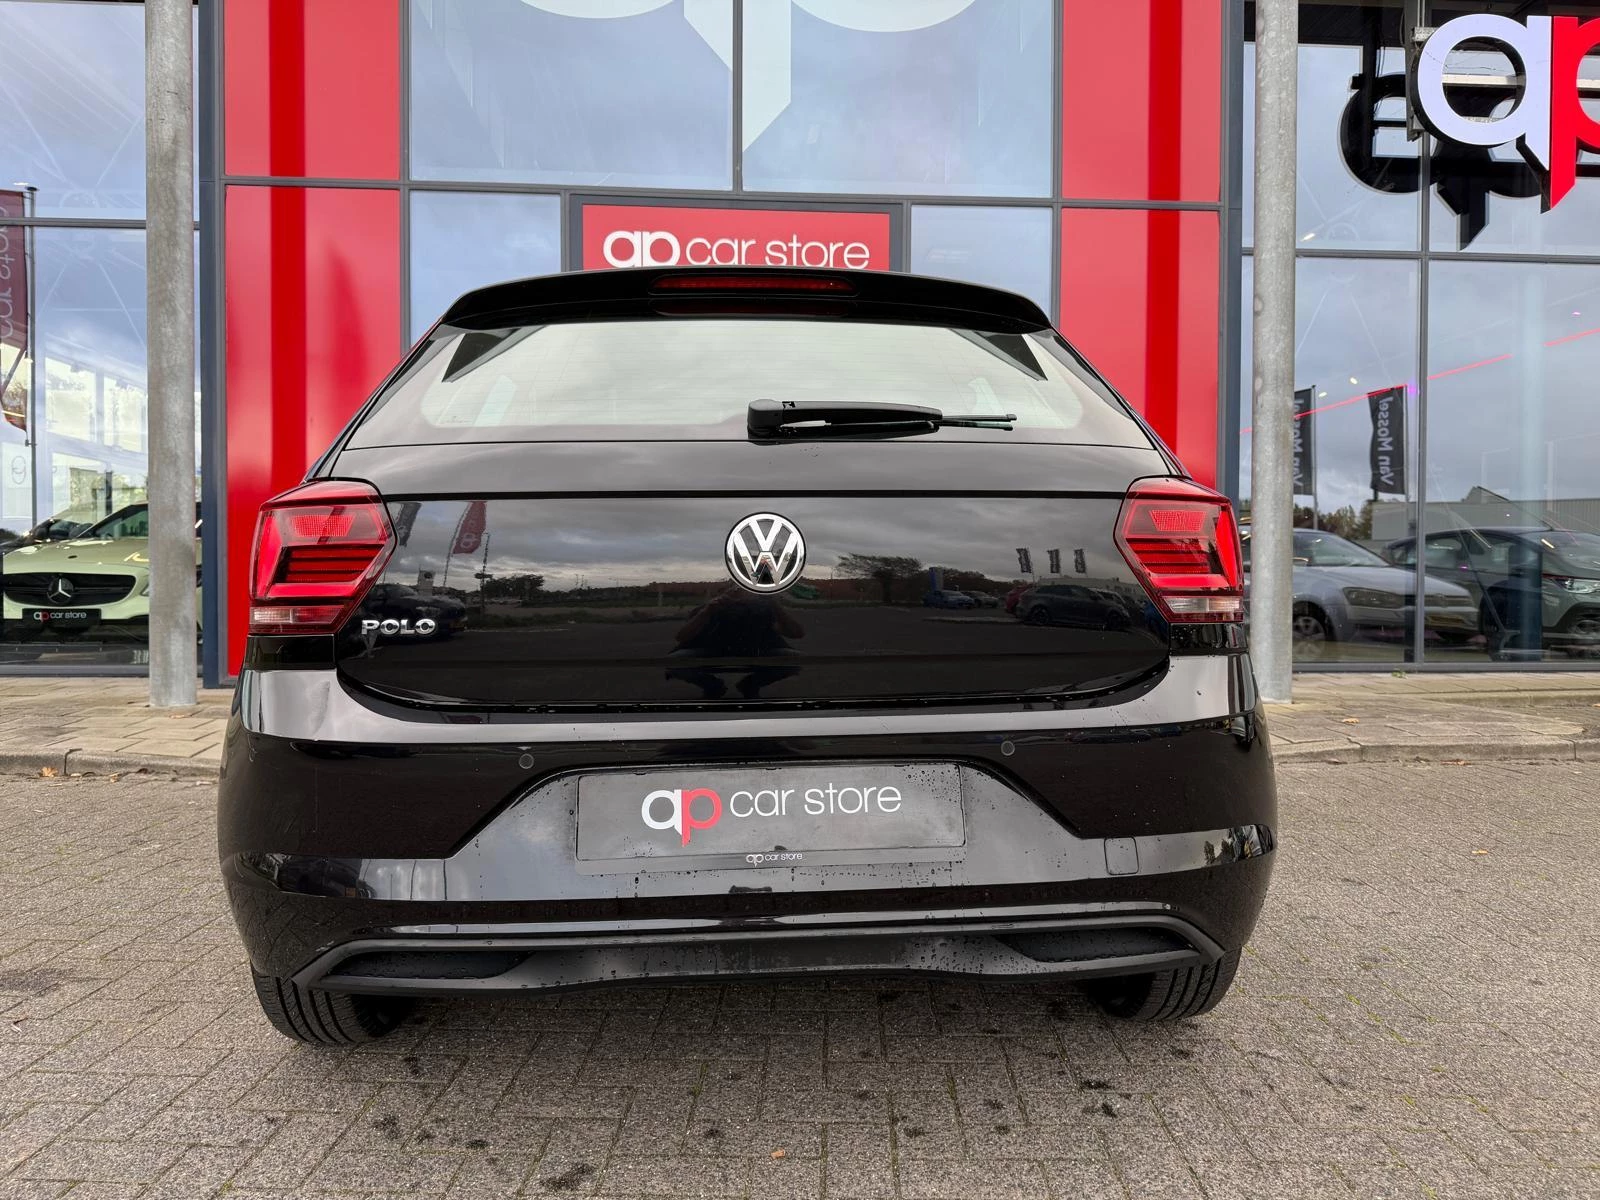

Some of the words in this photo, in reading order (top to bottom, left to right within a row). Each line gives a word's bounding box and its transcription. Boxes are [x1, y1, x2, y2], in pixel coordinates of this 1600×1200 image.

[686, 238, 756, 266] car
[765, 234, 870, 269] store
[49, 611, 63, 619] car
[64, 611, 87, 619] store
[361, 618, 436, 635] POLO
[730, 789, 795, 818] car
[804, 782, 902, 815] store
[780, 852, 803, 861] store
